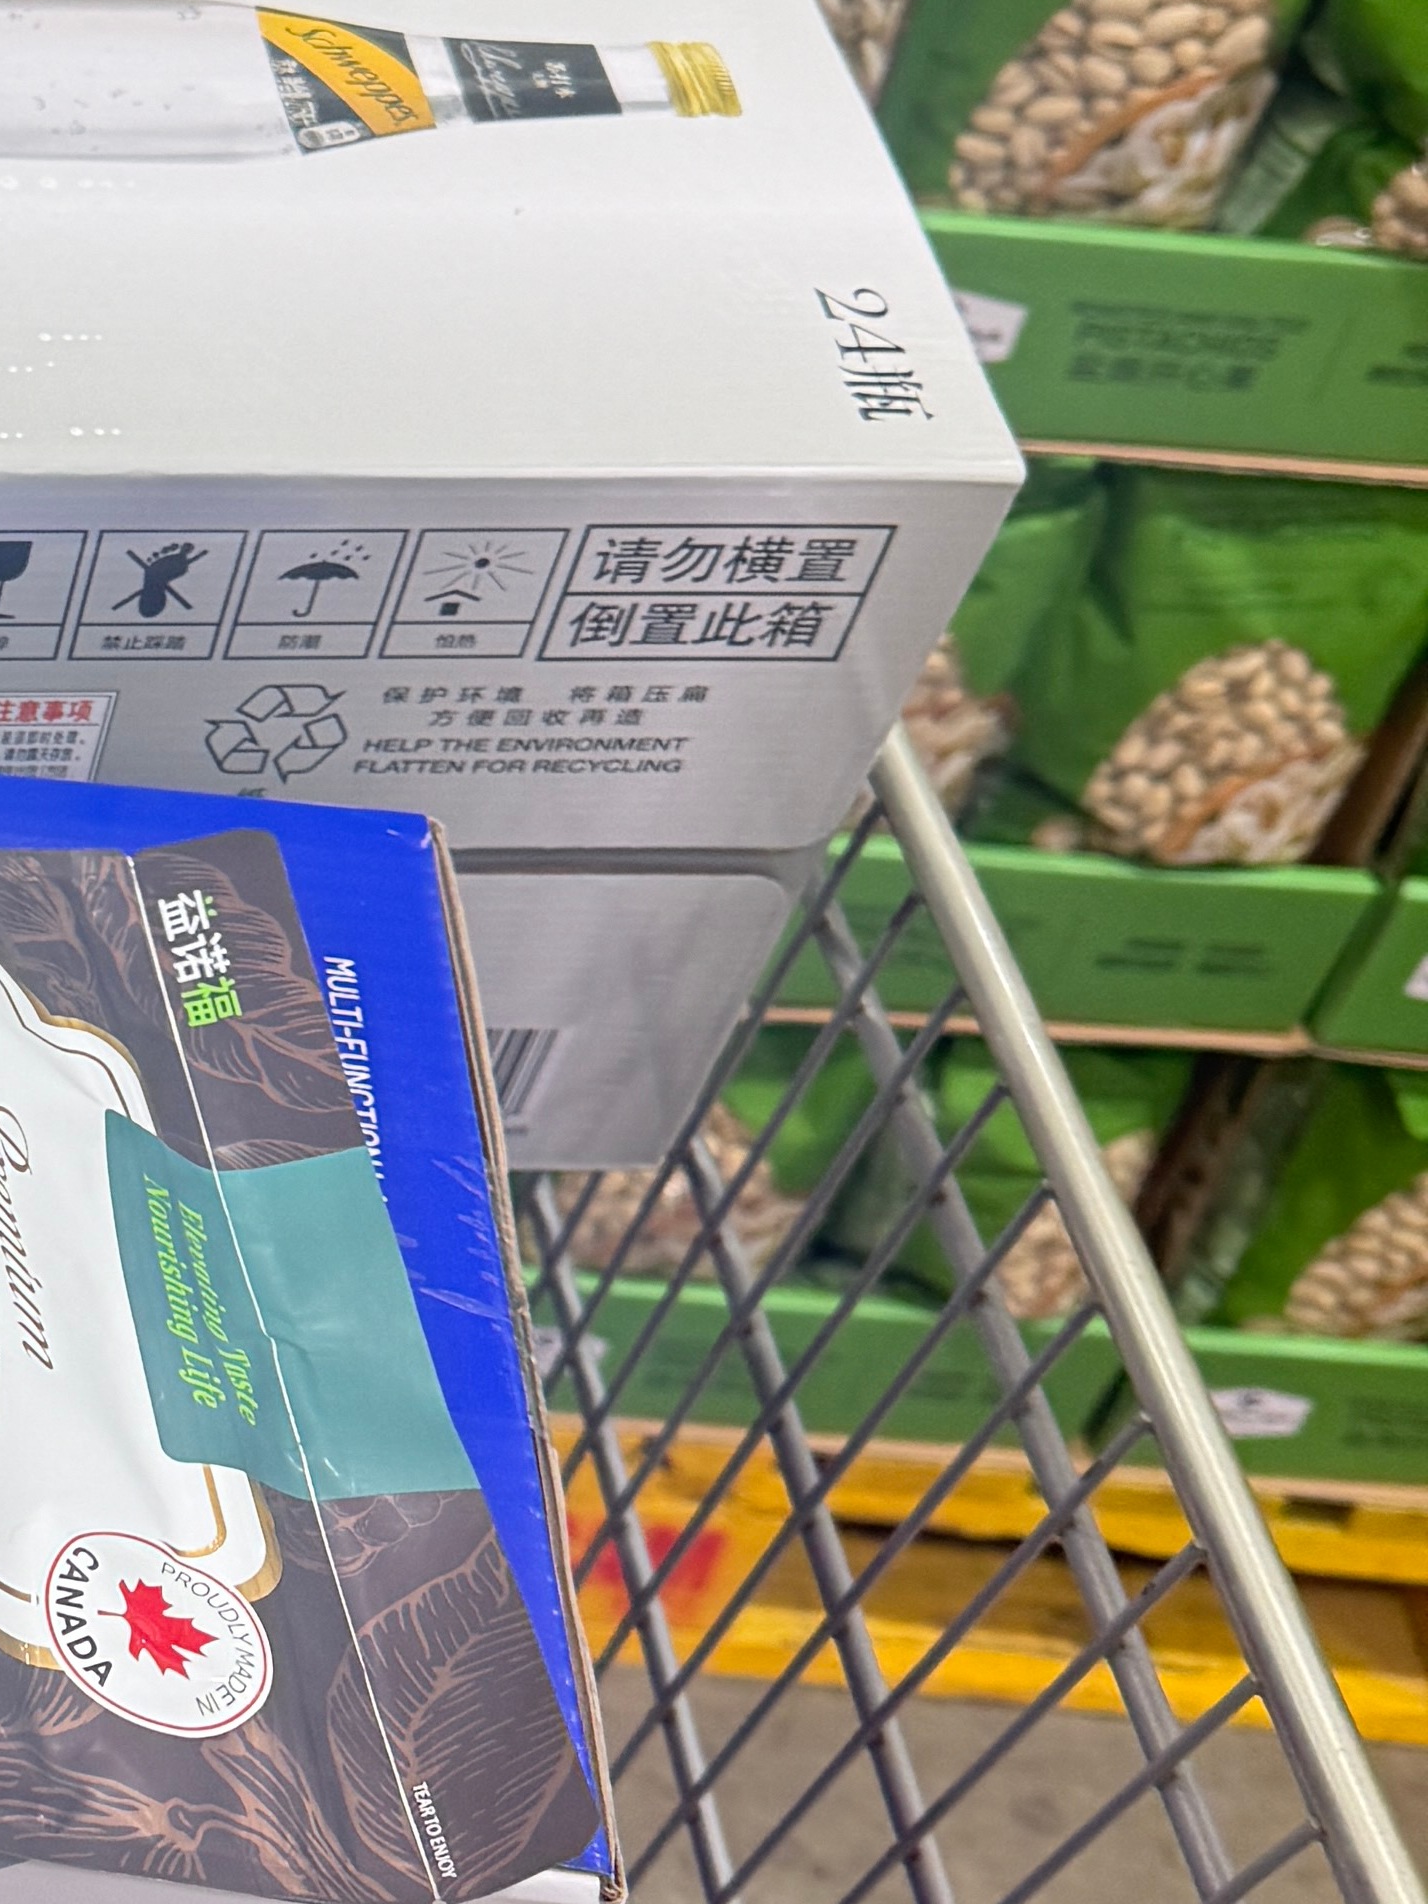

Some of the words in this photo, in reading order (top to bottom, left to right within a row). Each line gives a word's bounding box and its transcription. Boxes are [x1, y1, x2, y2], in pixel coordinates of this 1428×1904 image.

[284, 21, 418, 131] Schweppes
[811, 286, 935, 423] 24瓶
[592, 536, 859, 586] 请勿横置
[566, 601, 835, 650] 倒置此箱
[381, 685, 525, 707] 保护环境
[567, 684, 711, 705] 将箱压扁
[427, 707, 646, 729] 方便回收再造
[352, 757, 465, 775] FLATTEN
[469, 757, 527, 775] FOR
[530, 757, 684, 775] RECYCLING
[362, 737, 435, 754] HELP
[439, 737, 492, 754] THE
[494, 736, 691, 754] ENVIRONMENT
[158, 889, 243, 1028] 益诺福
[143, 1172, 201, 1345] Nourishing
[178, 1345, 227, 1410] Life
[177, 1199, 230, 1344] Elevating
[217, 1344, 257, 1428] Taste
[54, 1545, 114, 1690] CANADA
[160, 1559, 254, 1651] PROUDLY
[224, 1649, 257, 1709] MADE
[195, 1693, 221, 1718] IN
[412, 1780, 436, 1818] TEAR
[424, 1815, 443, 1837] TO
[429, 1835, 458, 1878] ENJOY
